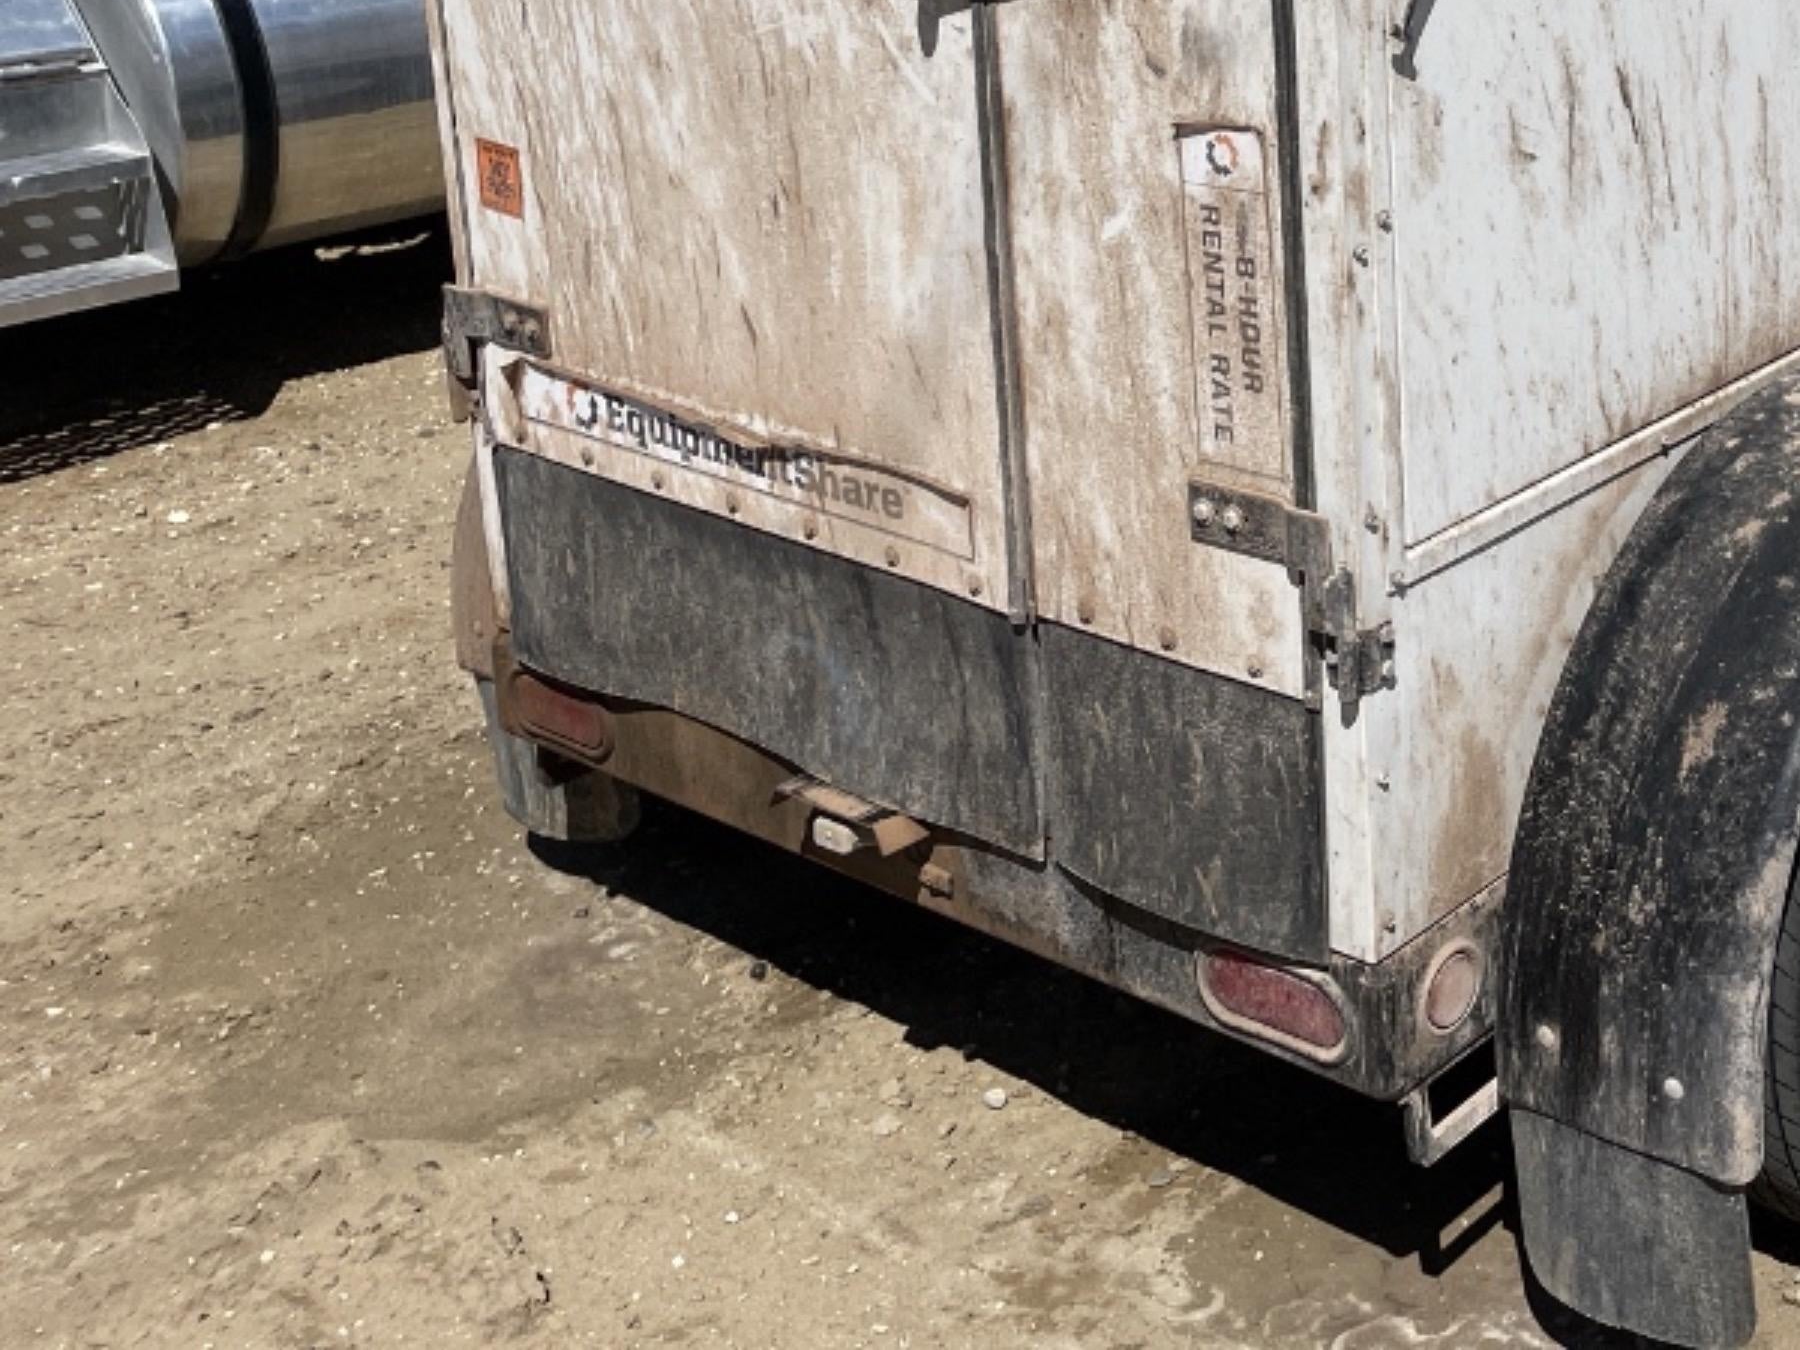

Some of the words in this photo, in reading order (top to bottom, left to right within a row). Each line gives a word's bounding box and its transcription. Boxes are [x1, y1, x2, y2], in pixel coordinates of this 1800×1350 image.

[1200, 203, 1227, 338] RENTAL
[1235, 256, 1264, 395] 8-HOUR
[1209, 353, 1235, 445] RATE
